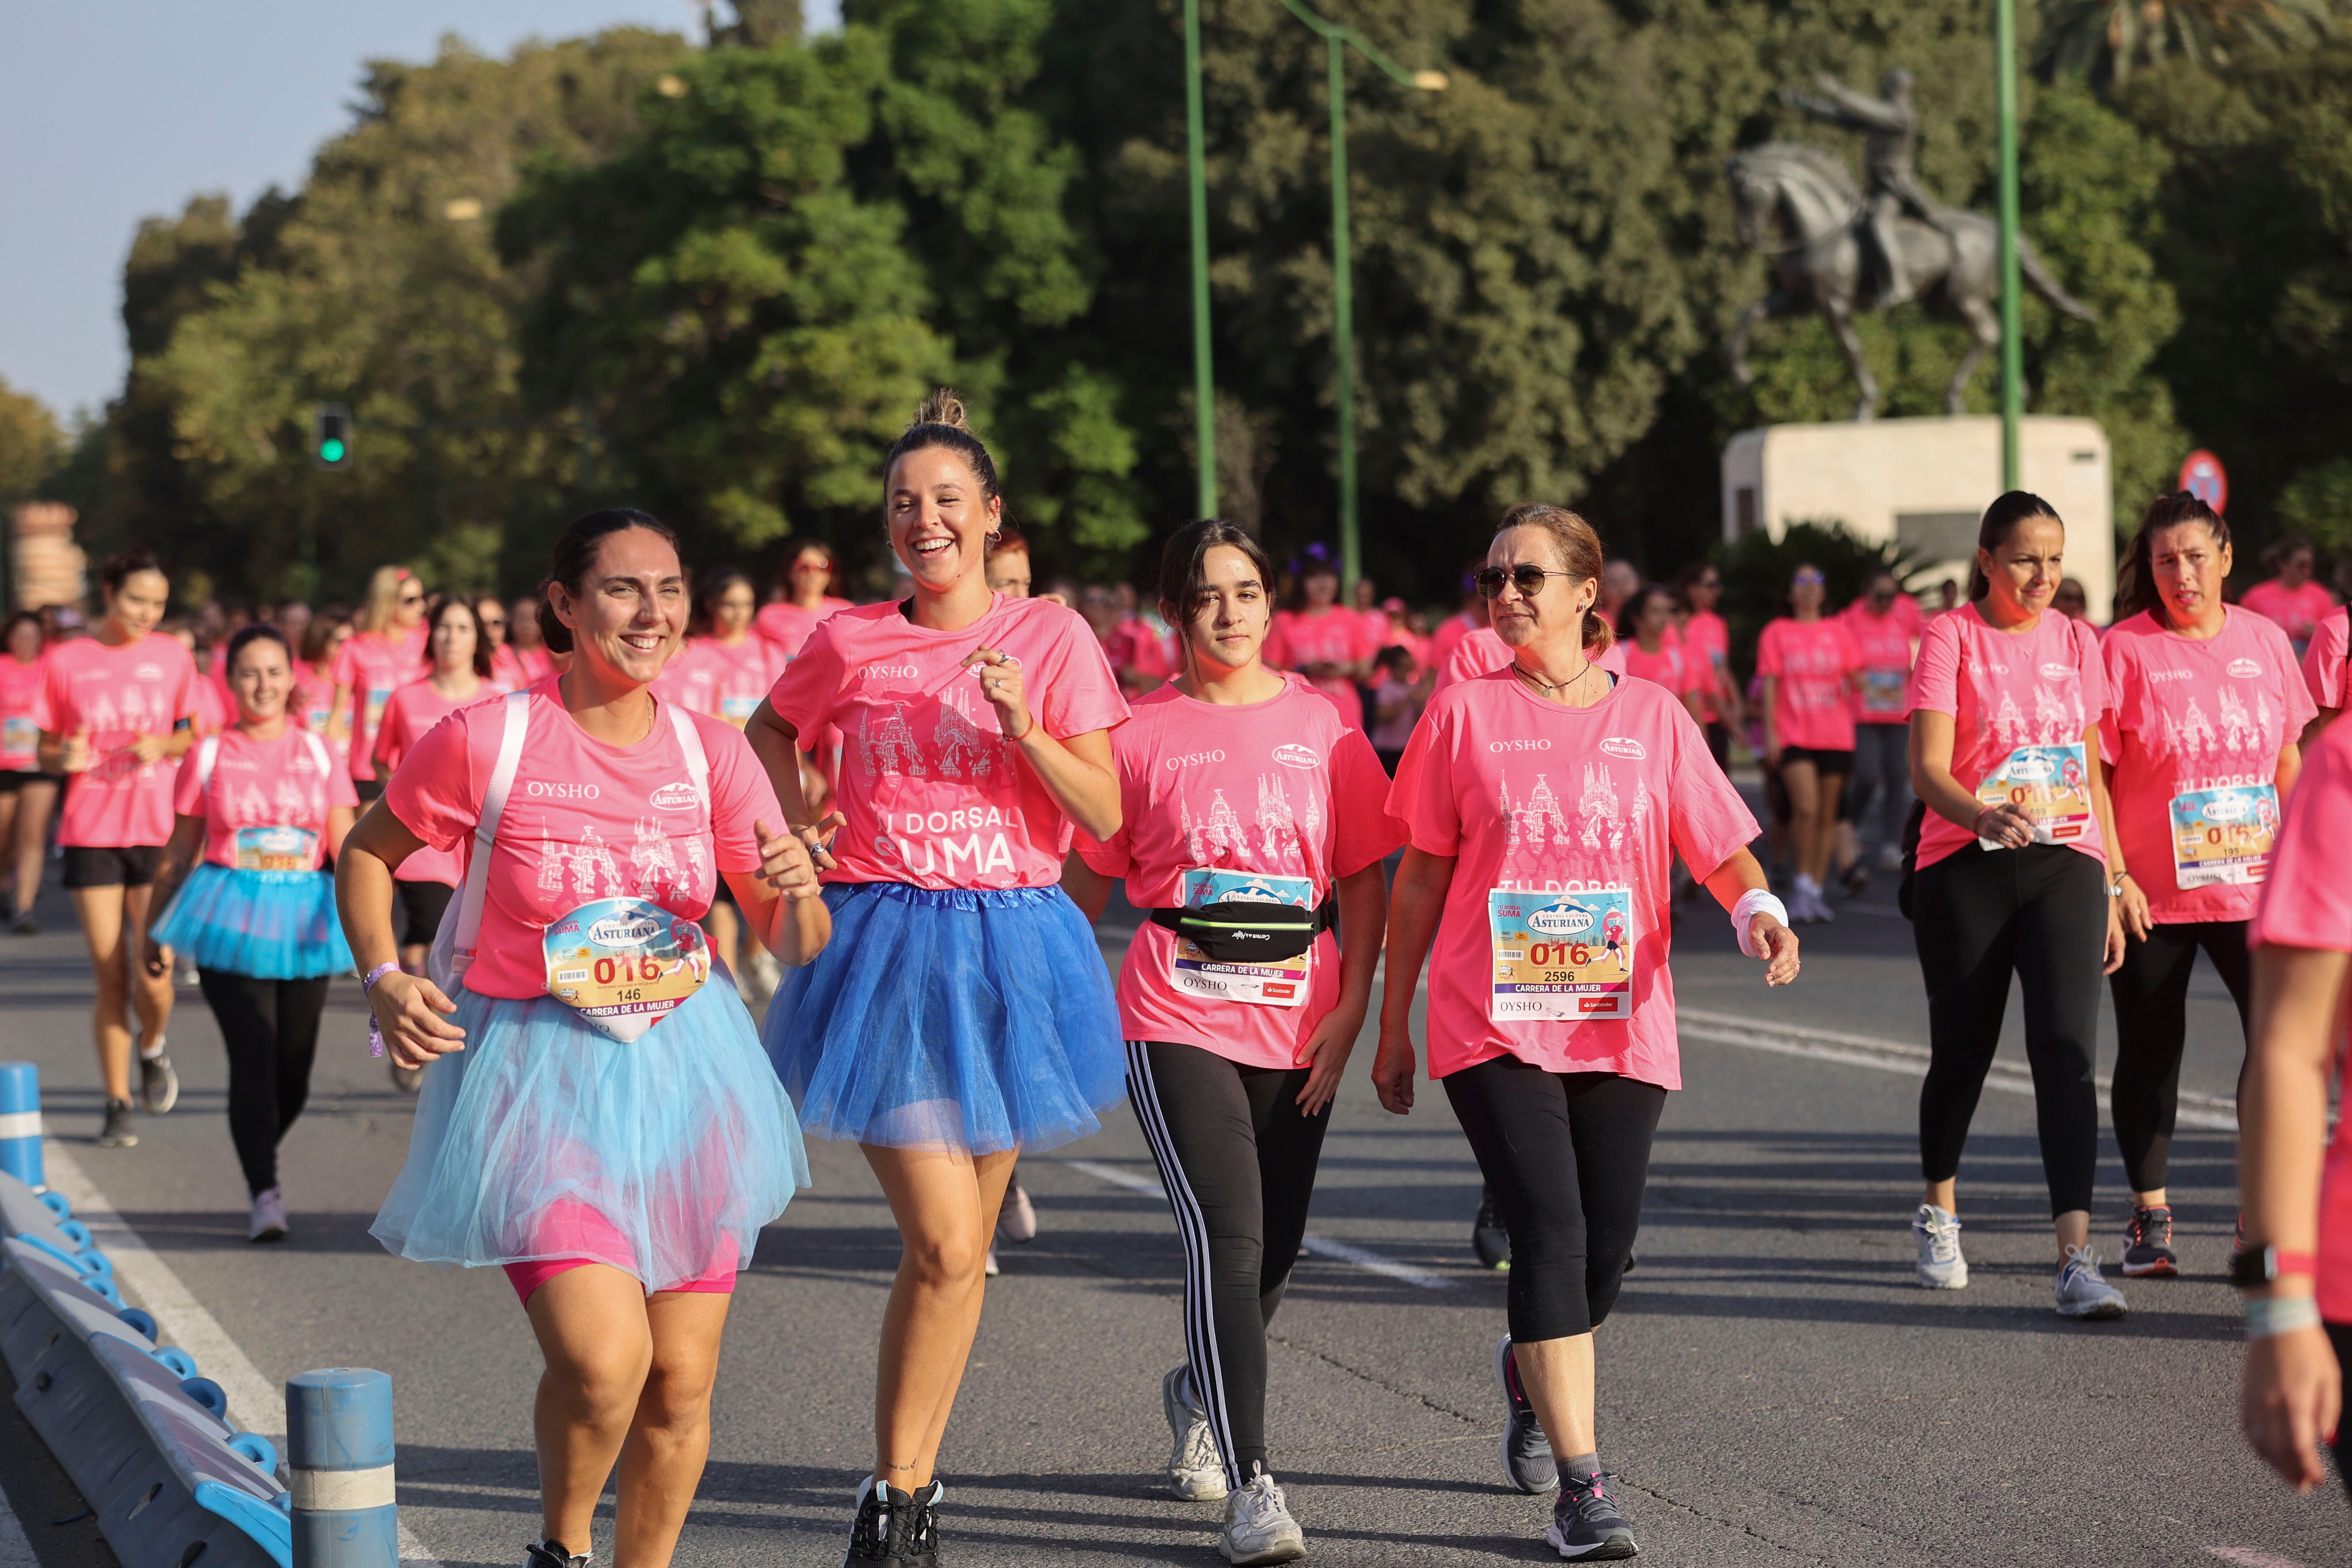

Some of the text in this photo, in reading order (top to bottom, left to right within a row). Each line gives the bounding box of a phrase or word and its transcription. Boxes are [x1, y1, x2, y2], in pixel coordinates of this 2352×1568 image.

[858, 665, 917, 680] OYSHO
[2149, 669, 2193, 683] OYSHO
[1490, 739, 1551, 753] OYSHO
[1166, 750, 1225, 770] OYSHO
[1276, 751, 1317, 765] ASTURIANA
[528, 782, 599, 799] OYSHO
[906, 806, 1018, 834] DORSAL
[874, 833, 1017, 877] SUMA
[2224, 848, 2239, 857] 195
[1193, 887, 1213, 896] SUMA
[1532, 915, 1590, 927] ASTURIANA
[554, 924, 580, 936] SUMA
[593, 926, 655, 941] ASTURIANA
[1530, 943, 1589, 965] 016
[594, 954, 660, 984] 016
[1202, 963, 1235, 973] CARRERA
[1261, 968, 1284, 978] MUJER
[1545, 971, 1575, 982] 2596
[1184, 977, 1227, 991] OYSHO
[617, 988, 641, 1002] 146
[580, 1000, 675, 1016] CARRERA DE LA MUJER
[1501, 1002, 1542, 1012] OYSHO
